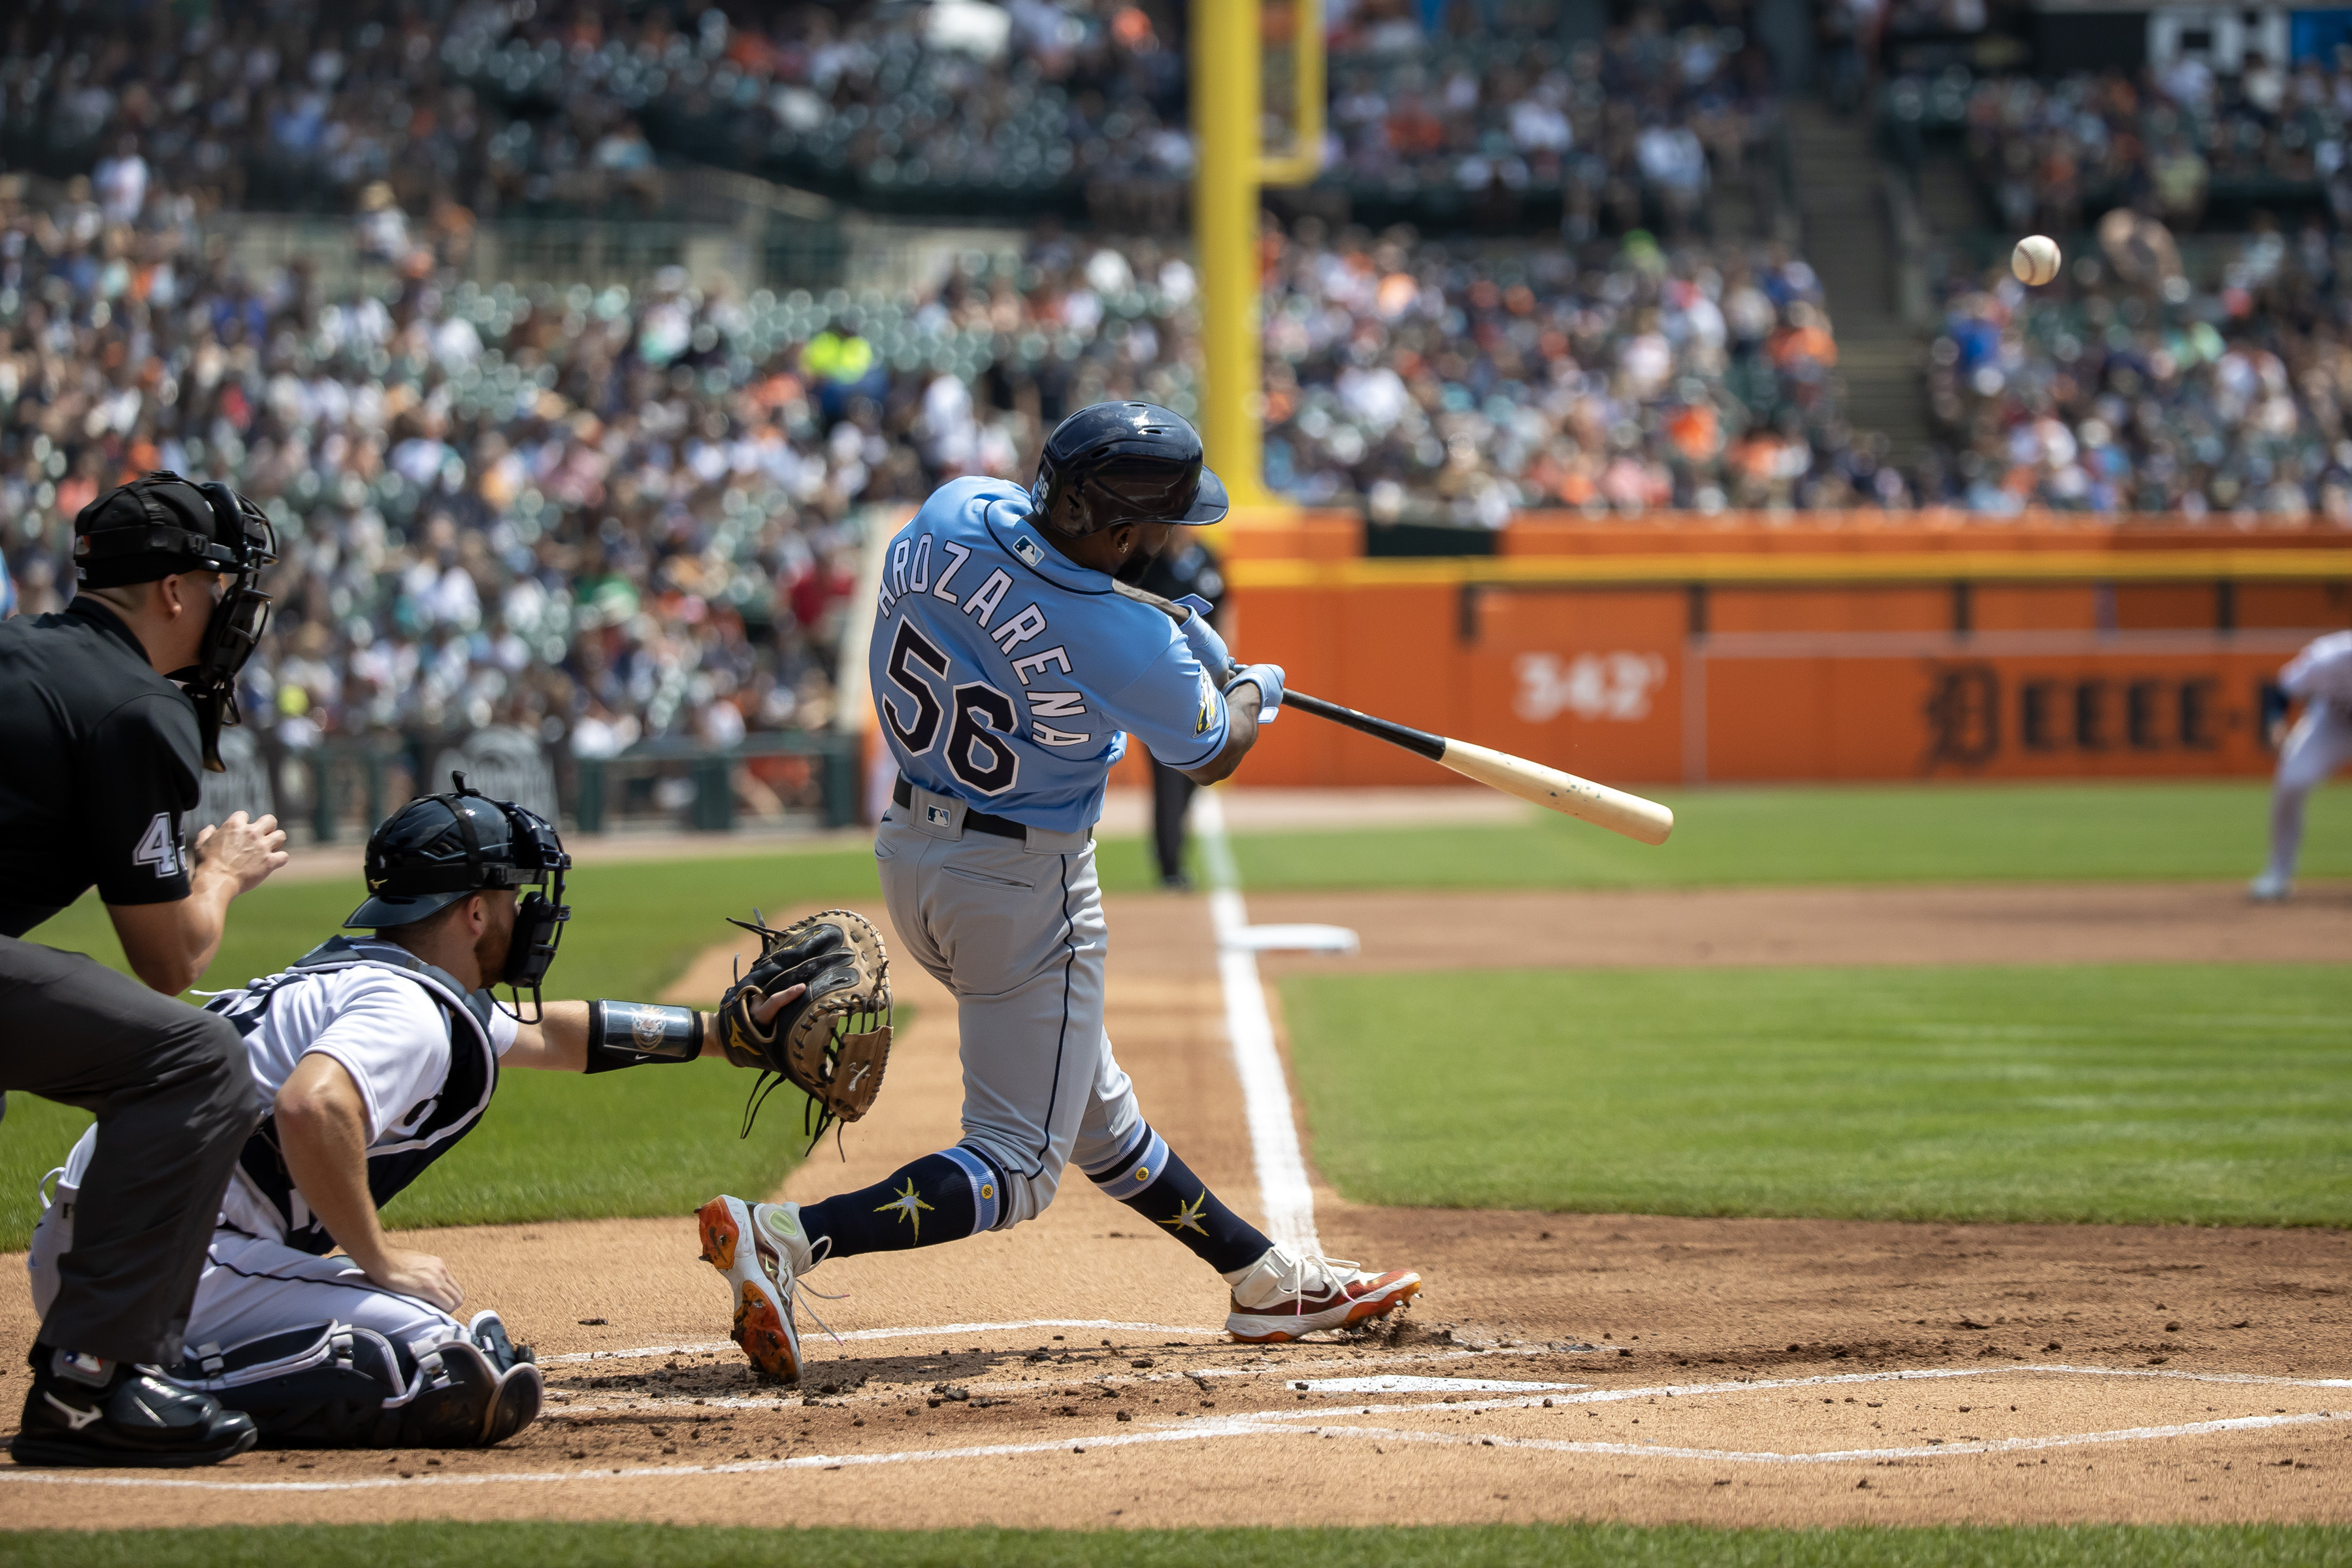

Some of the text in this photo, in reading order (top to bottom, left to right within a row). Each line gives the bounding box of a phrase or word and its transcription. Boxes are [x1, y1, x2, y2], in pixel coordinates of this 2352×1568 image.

[1037, 470, 1049, 500] 56
[878, 532, 1091, 747] AROZARENA
[882, 613, 1020, 797] 56
[132, 811, 188, 878] 4
